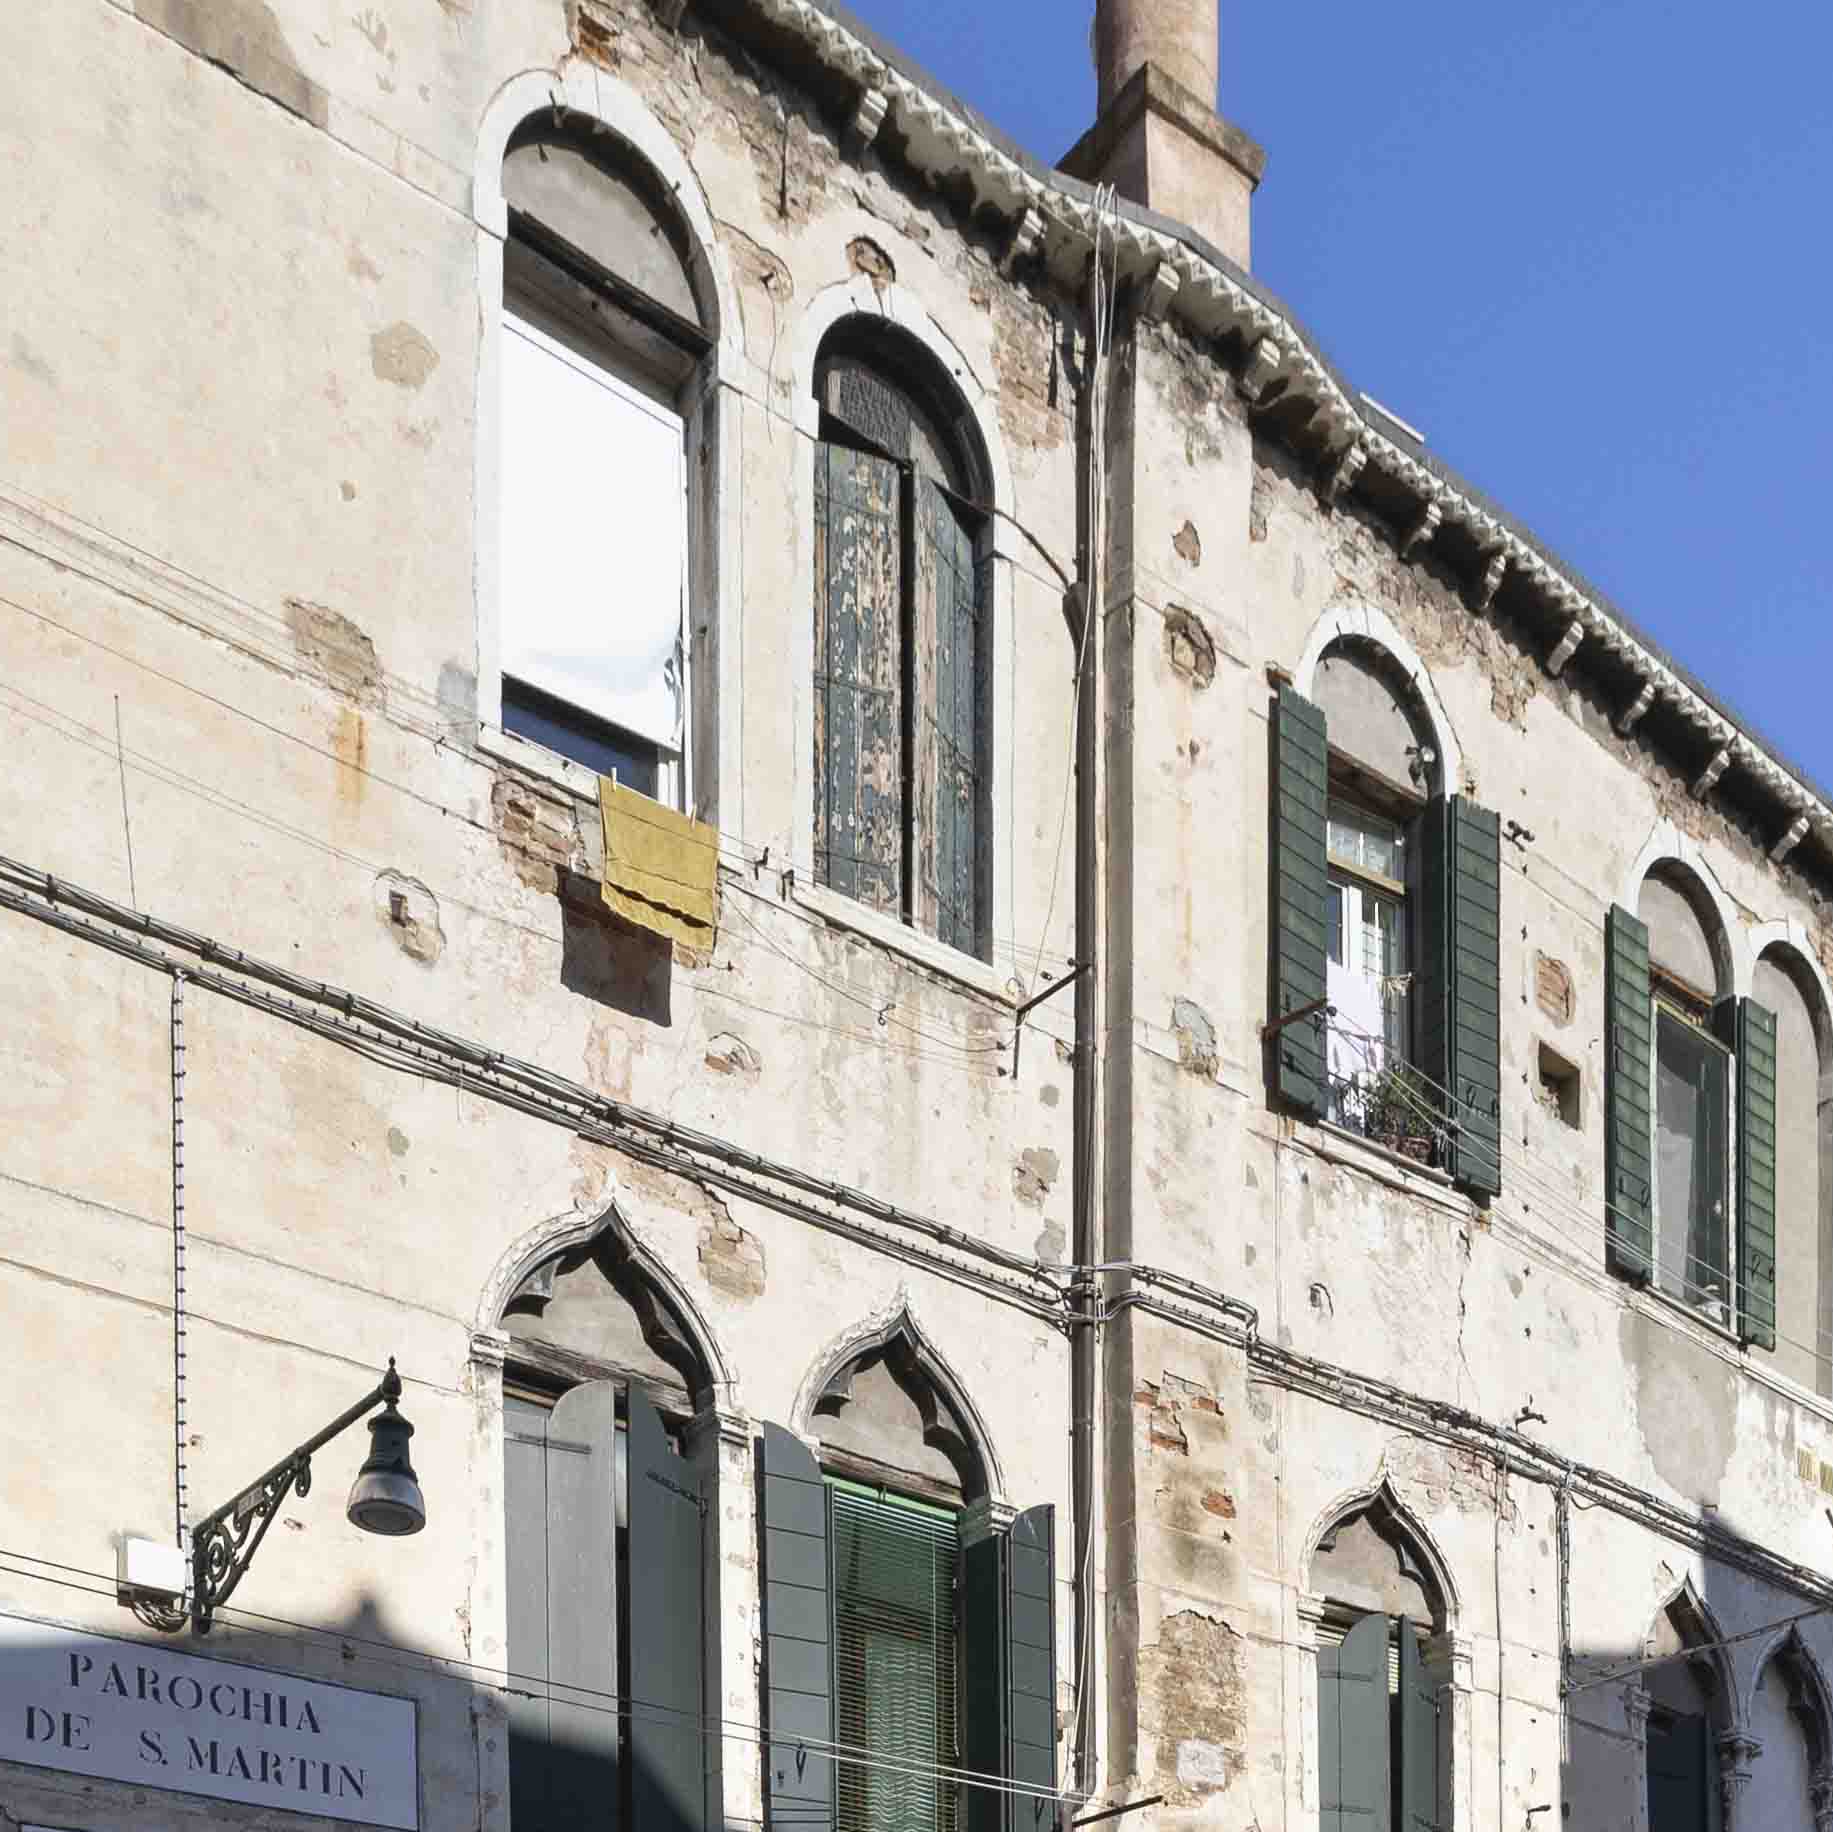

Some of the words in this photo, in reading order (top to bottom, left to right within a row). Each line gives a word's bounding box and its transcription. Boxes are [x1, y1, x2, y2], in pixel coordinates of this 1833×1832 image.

[68, 1653, 321, 1734] PAROCHIA
[25, 1706, 91, 1751] DE
[138, 1729, 168, 1766] S.
[187, 1737, 368, 1800] MARTIN
